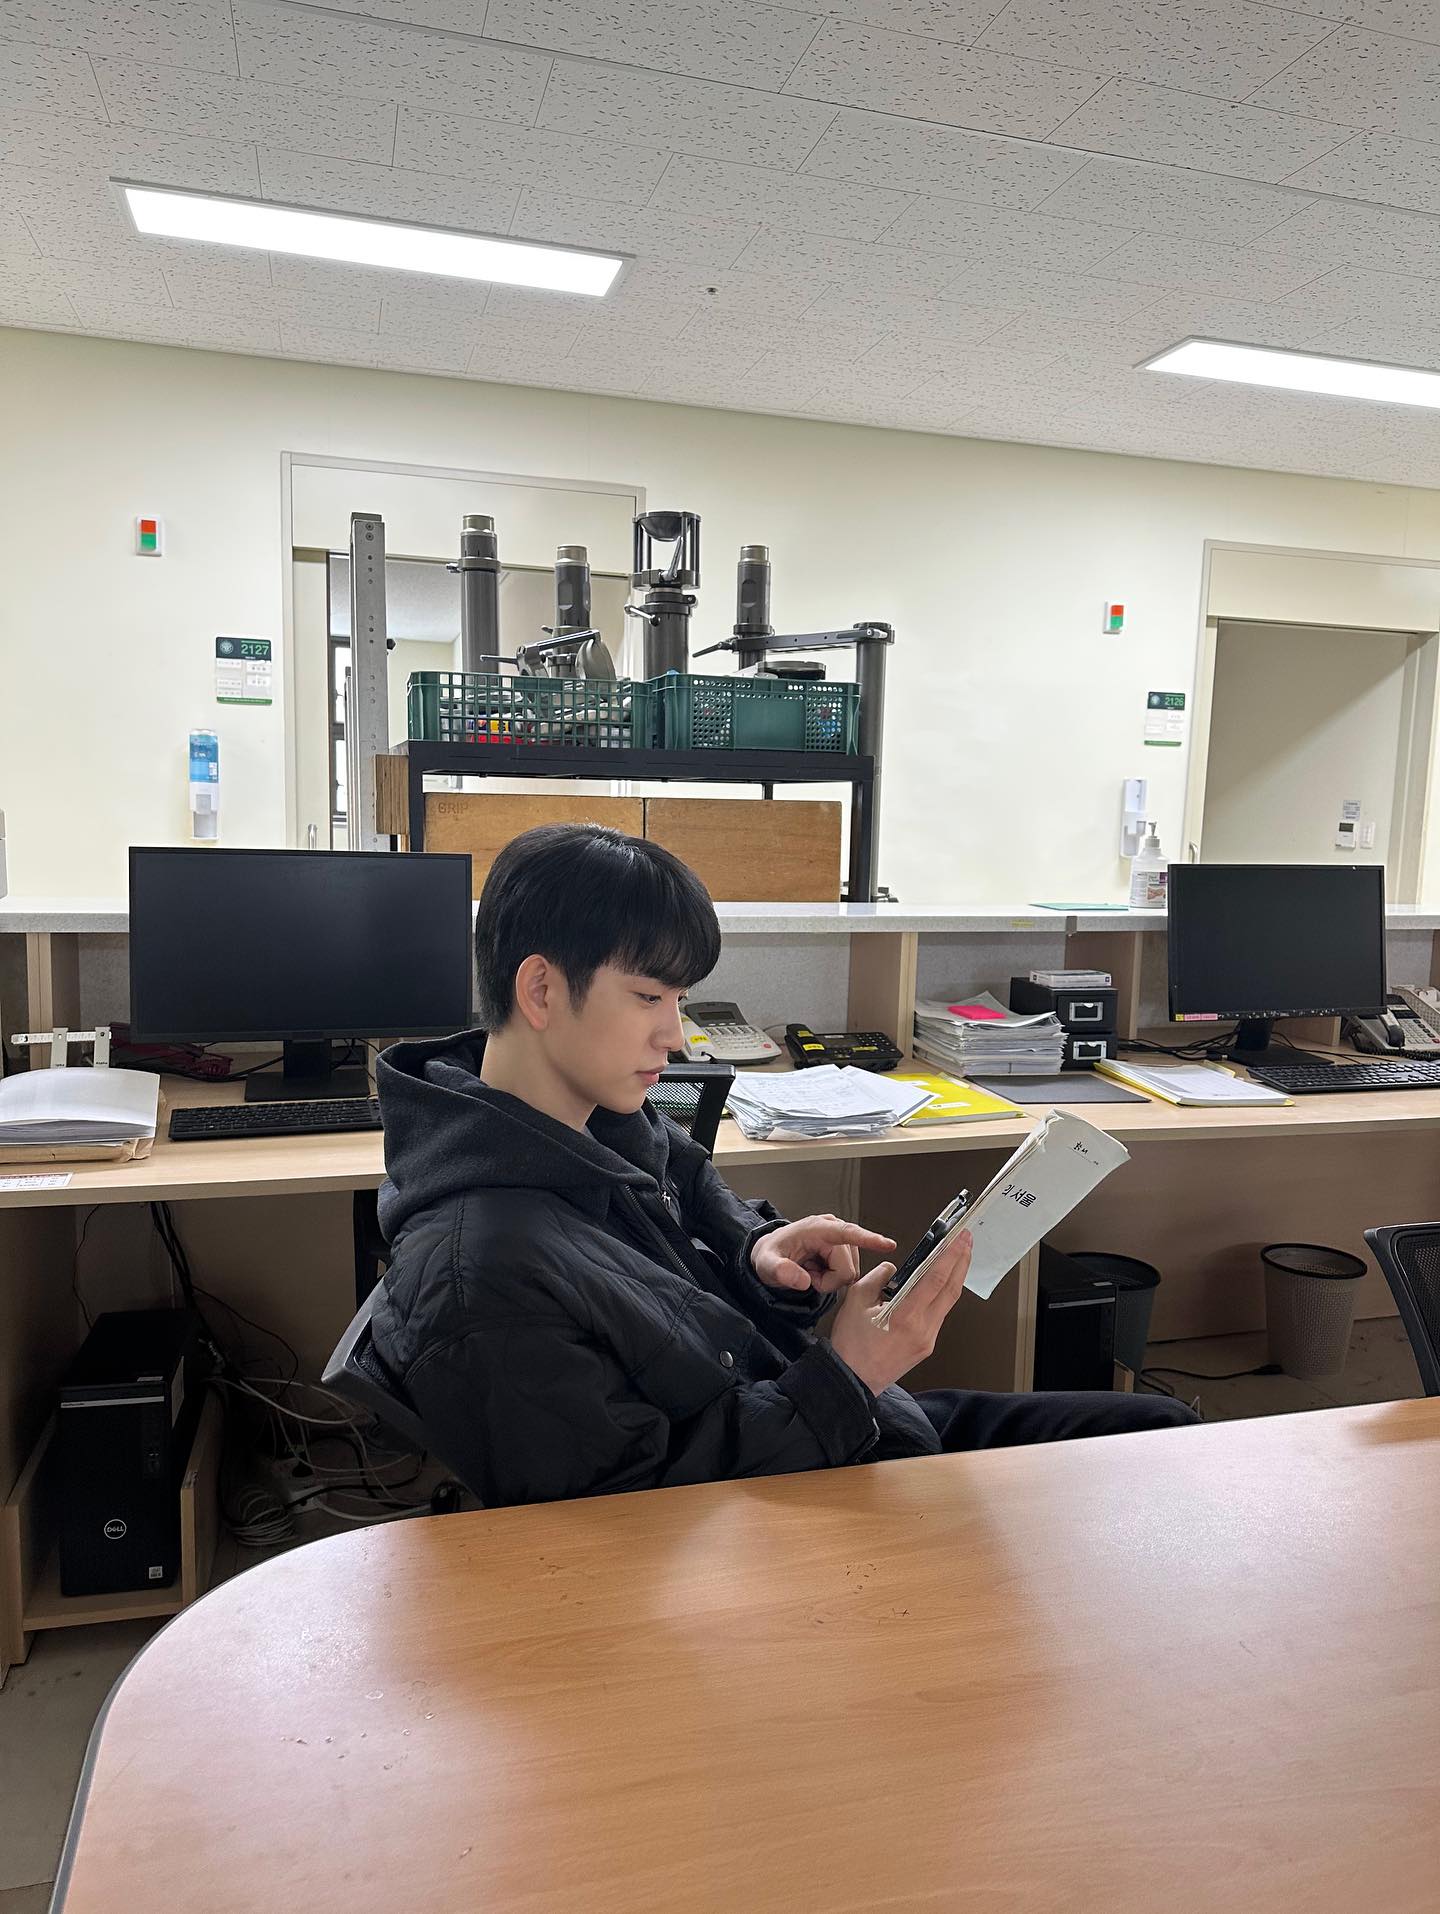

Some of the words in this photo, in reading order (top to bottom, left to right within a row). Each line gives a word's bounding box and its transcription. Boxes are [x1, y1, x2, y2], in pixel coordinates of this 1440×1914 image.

[241, 643, 269, 655] 2127
[1164, 696, 1184, 706] 2126
[438, 801, 469, 815] GRIP
[1009, 1188, 1037, 1208] 서울
[107, 1525, 125, 1533] DELL
